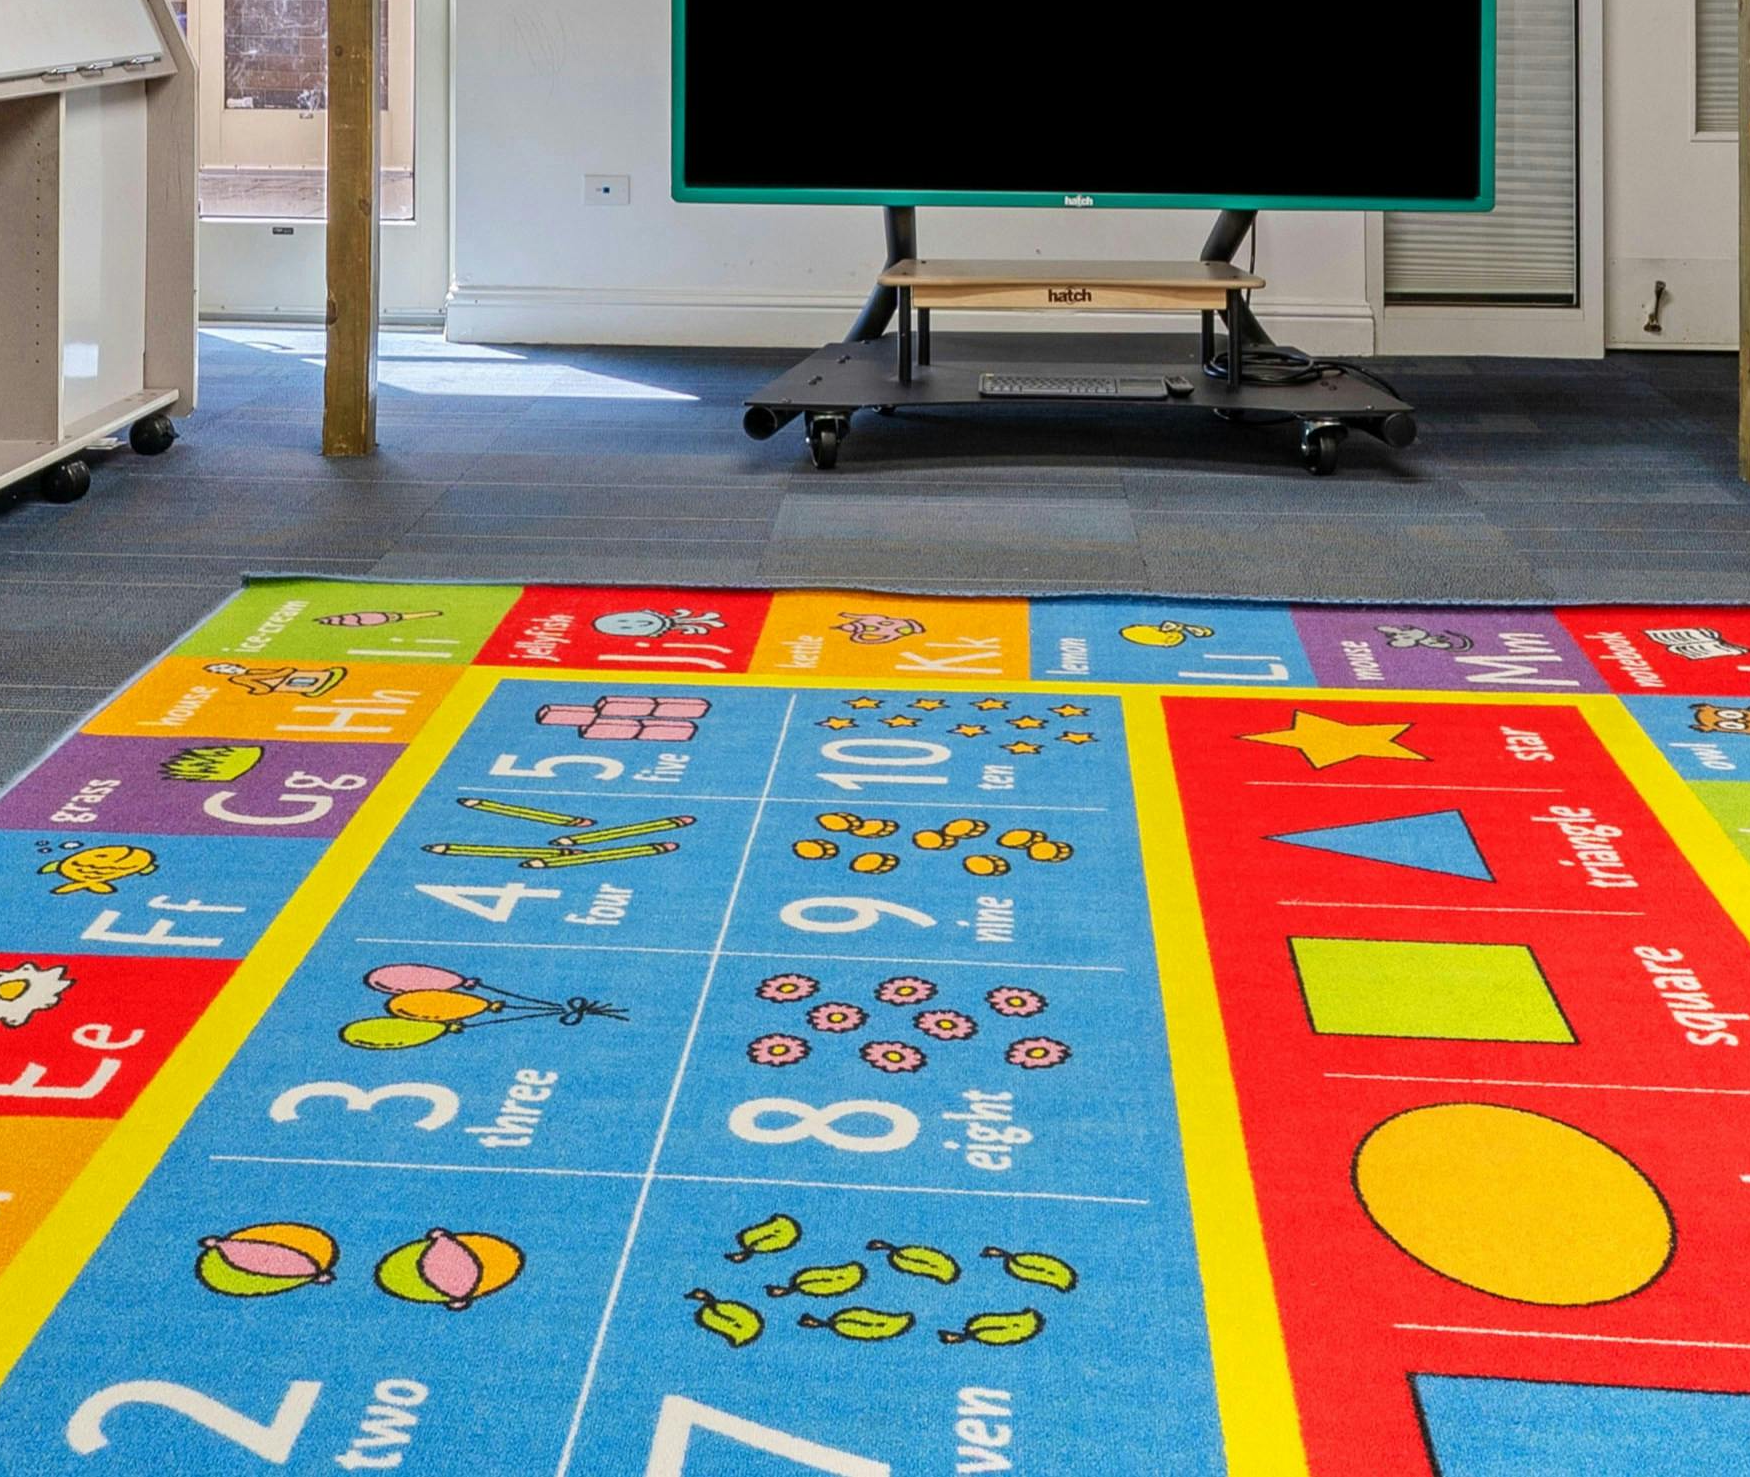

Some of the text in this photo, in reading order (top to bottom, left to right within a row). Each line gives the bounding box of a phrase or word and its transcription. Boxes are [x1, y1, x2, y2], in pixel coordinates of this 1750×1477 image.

[1064, 194, 1094, 207] hatch
[1048, 287, 1092, 304] hatch
[222, 598, 310, 656] ice-cream
[507, 611, 577, 663] jellyfish
[774, 633, 824, 671] kettle
[1045, 636, 1090, 676] lemon
[1340, 640, 1385, 681] mouse
[1582, 630, 1668, 689] notebook
[150, 684, 219, 728] house
[817, 738, 951, 790] 10
[1500, 724, 1555, 762] star
[1670, 742, 1736, 770] owl
[489, 753, 624, 781] 5
[632, 751, 690, 785] five
[978, 764, 1014, 790] ten
[50, 779, 121, 823] grass
[1531, 805, 1639, 889] triangle
[415, 882, 561, 922] 4
[565, 883, 633, 925] four
[779, 896, 937, 933] 9
[957, 896, 1014, 942] nine
[1634, 944, 1740, 1048] square
[269, 1081, 460, 1131] 3
[465, 1069, 558, 1148] three
[728, 1097, 921, 1153] 8
[942, 1089, 1033, 1171] eight
[66, 1380, 322, 1464] 2
[335, 1379, 428, 1470] two
[645, 1395, 891, 1477] 7
